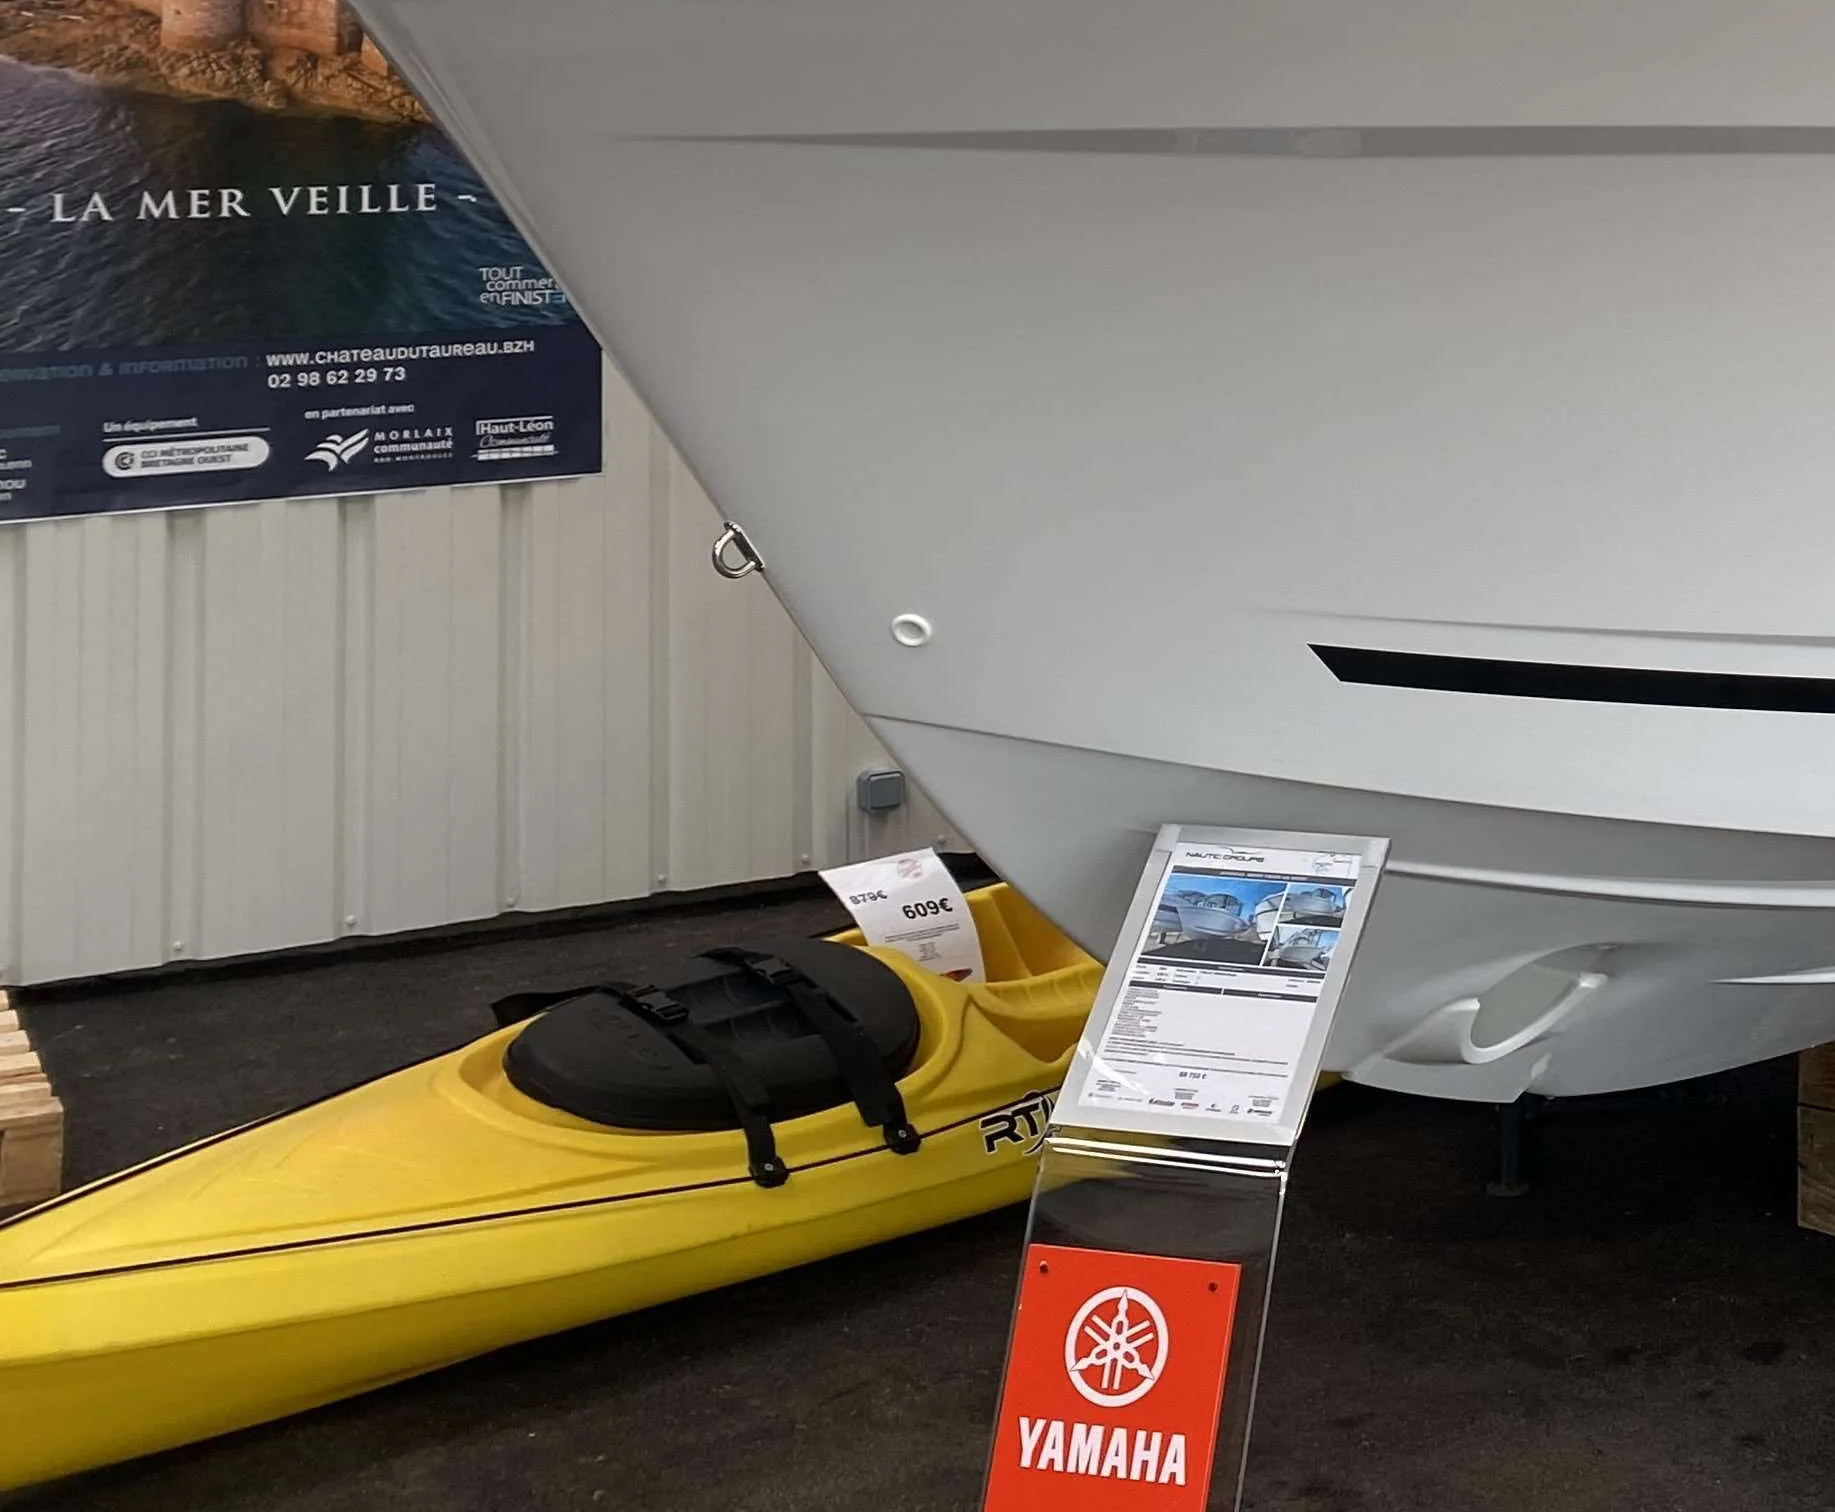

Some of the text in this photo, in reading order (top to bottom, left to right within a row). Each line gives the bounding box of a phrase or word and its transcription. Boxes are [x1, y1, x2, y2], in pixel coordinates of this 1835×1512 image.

[51, 183, 438, 223] LA MER VEILLE
[479, 266, 523, 281] TOUT
[480, 291, 501, 304] en
[267, 367, 406, 389] 02 98 62 29 73
[304, 410, 320, 420] en
[321, 405, 386, 421] partenariat
[374, 427, 453, 441] MORLAIX
[480, 420, 553, 434] Haut-Léon
[374, 437, 453, 454] communauté
[902, 898, 953, 919] 609€
[1018, 1416, 1187, 1487] YAMAHA
